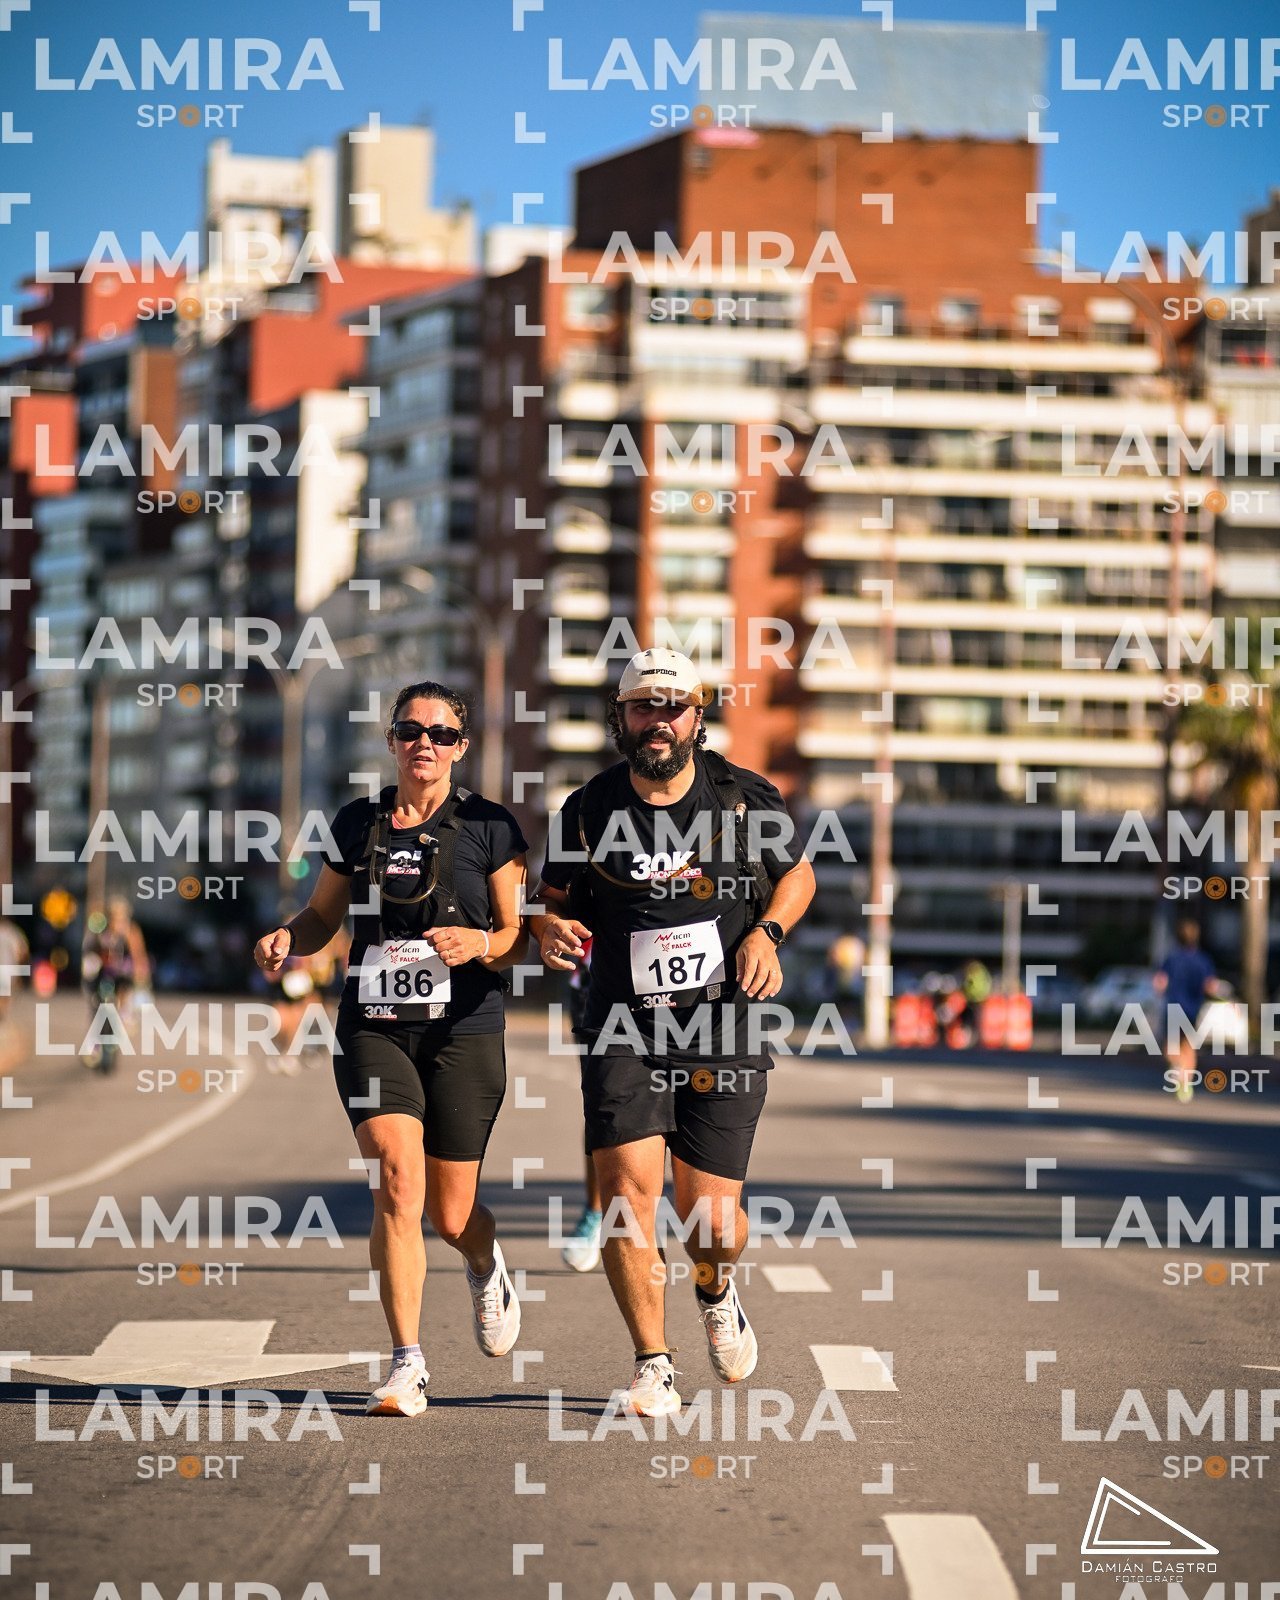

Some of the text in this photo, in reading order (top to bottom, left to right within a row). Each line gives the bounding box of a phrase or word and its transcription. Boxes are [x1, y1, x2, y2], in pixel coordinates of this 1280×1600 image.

[630, 850, 696, 881] 30K
[671, 941, 692, 950] FALCK
[648, 952, 707, 987] 187
[379, 969, 434, 998] 186
[364, 1005, 395, 1019] 30K
[642, 993, 673, 1009] 30K
